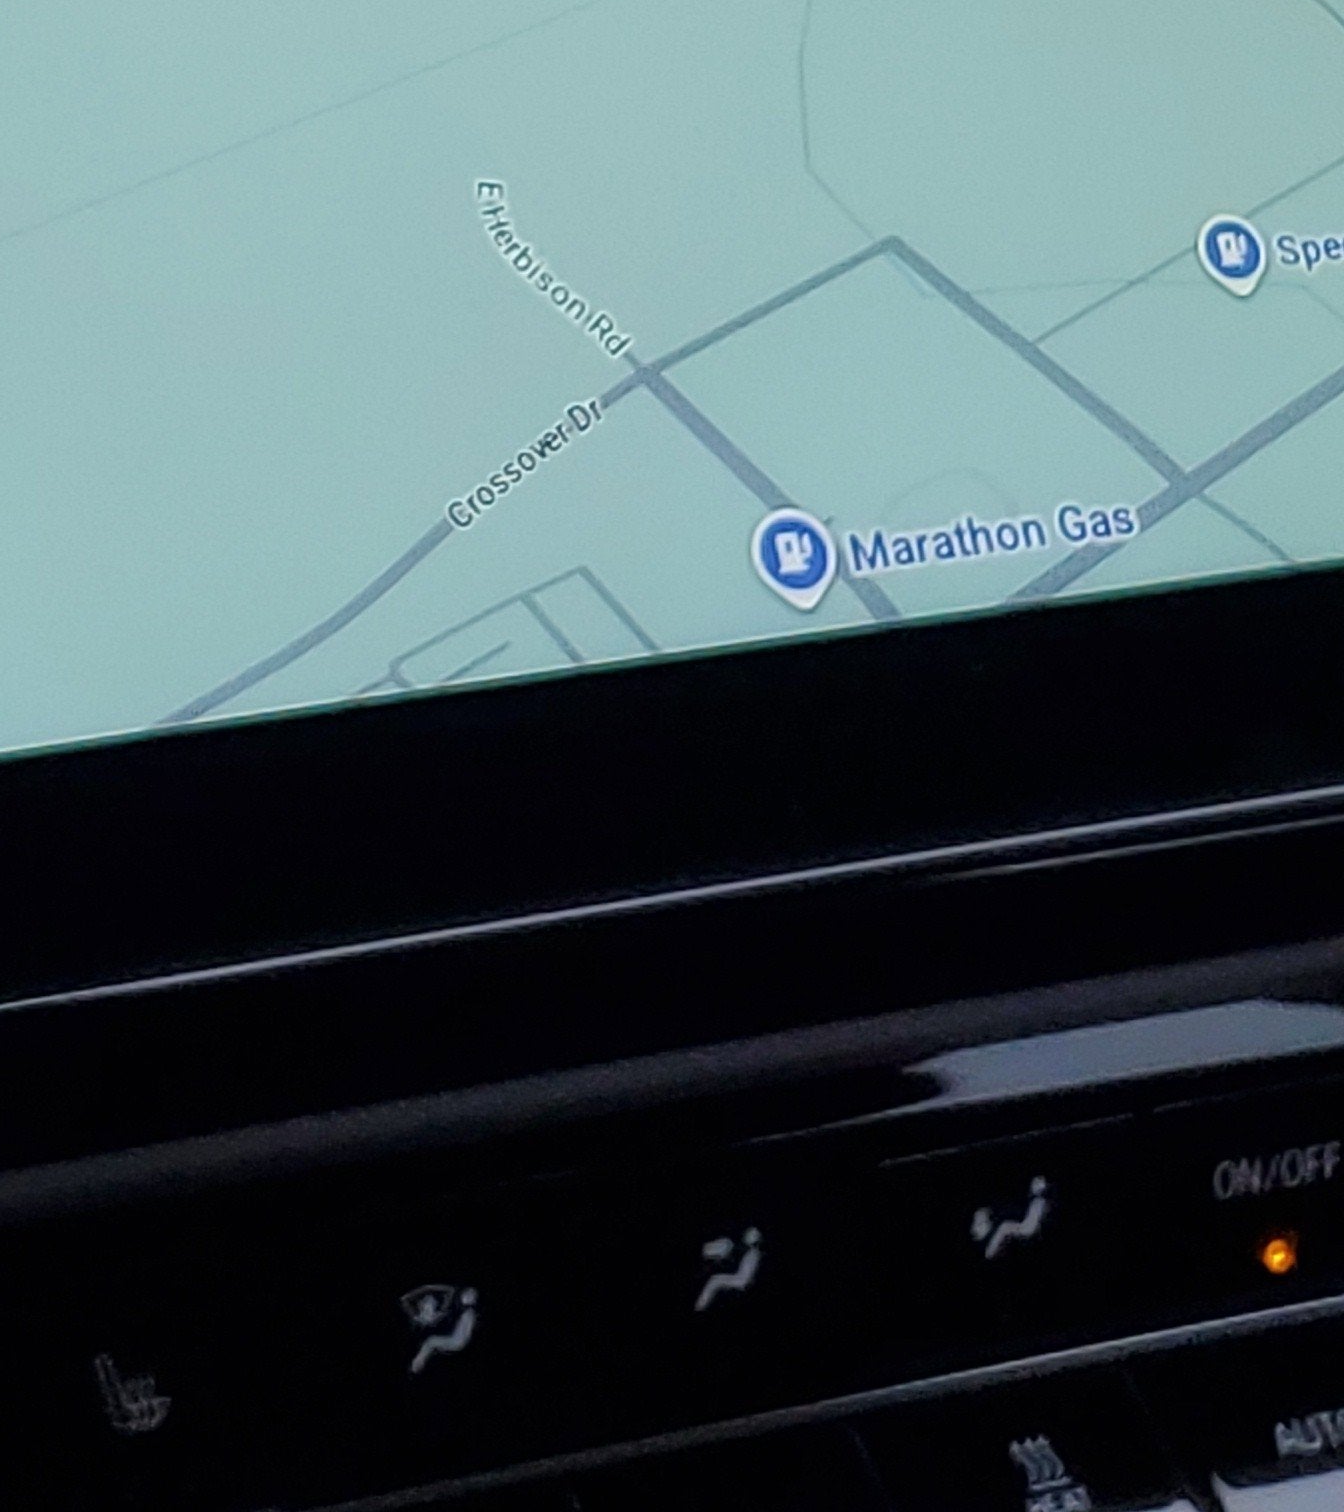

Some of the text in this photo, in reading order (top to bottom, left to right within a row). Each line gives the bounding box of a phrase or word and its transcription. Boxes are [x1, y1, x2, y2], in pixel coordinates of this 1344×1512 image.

[476, 179, 633, 358] E Herbison Rd
[446, 397, 605, 530] Crossover Dr
[847, 503, 1138, 573] Marathon Gas
[1212, 1140, 1342, 1201] ON/OFF
